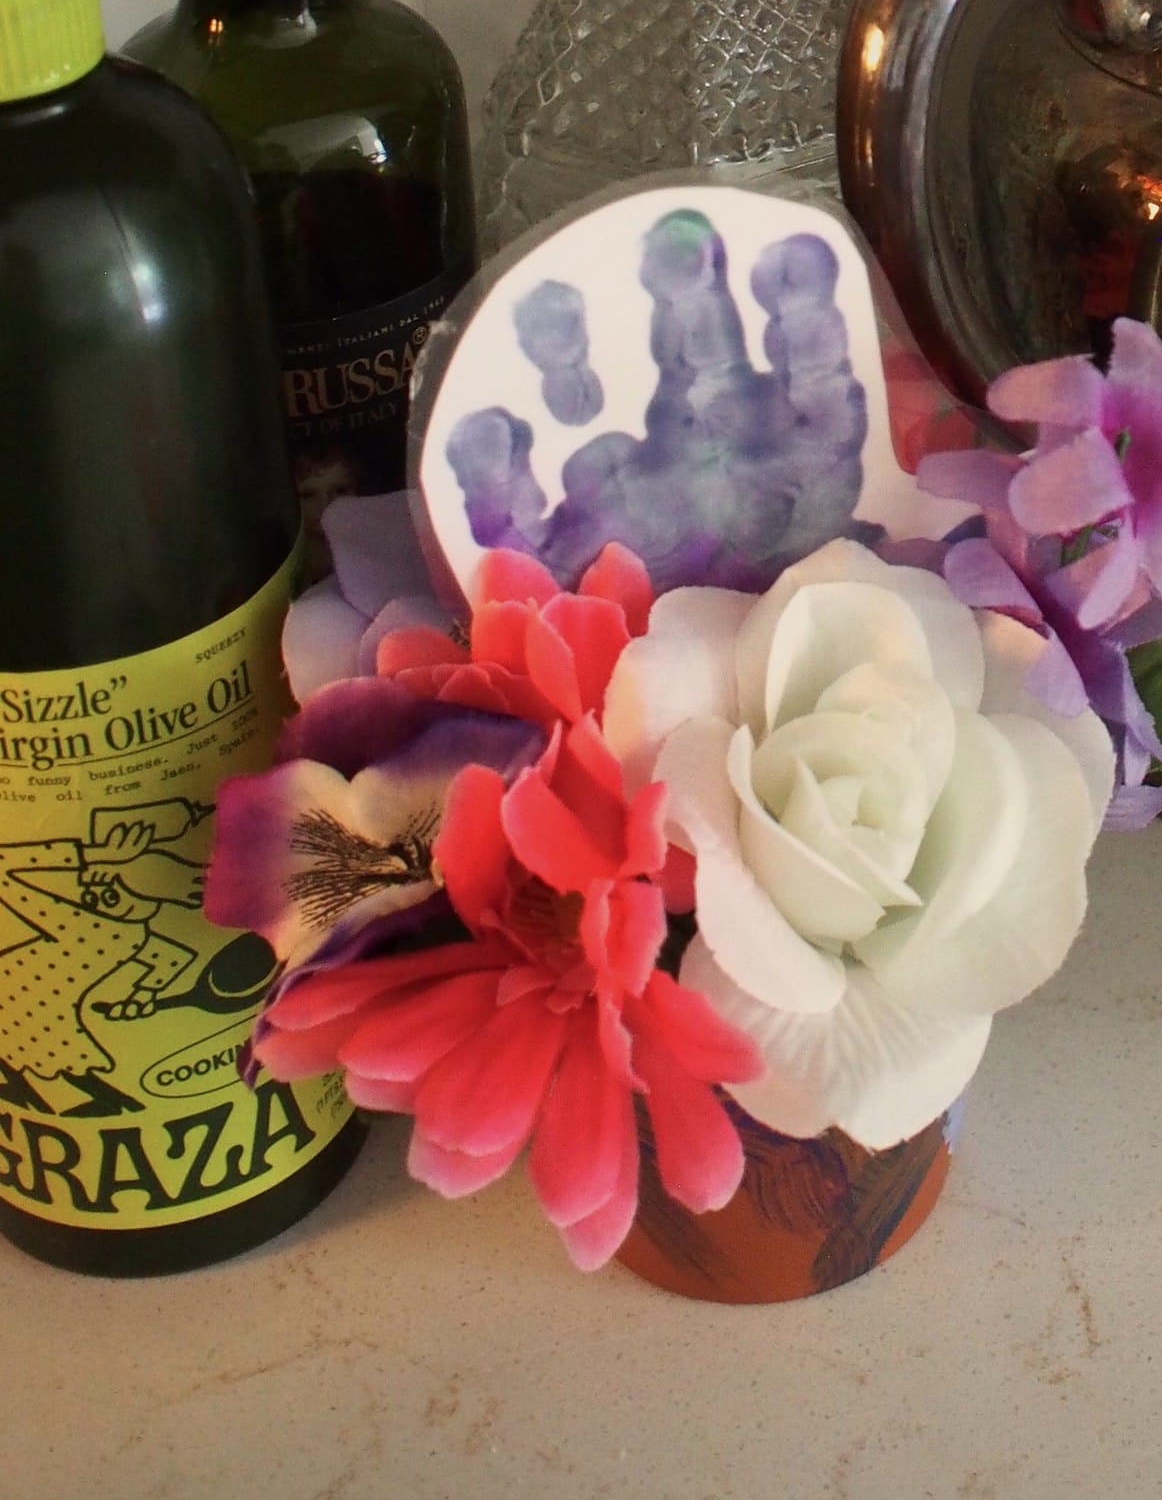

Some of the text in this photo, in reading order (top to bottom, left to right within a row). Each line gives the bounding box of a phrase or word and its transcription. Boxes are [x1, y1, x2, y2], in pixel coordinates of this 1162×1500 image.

[194, 628, 248, 664] SQUEEZY
[0, 658, 254, 772] irgin Olive Oil
[27, 774, 72, 788] funny
[88, 757, 170, 782] business.
[0, 789, 36, 803] live
[56, 789, 84, 802] oil
[104, 779, 142, 796] from
